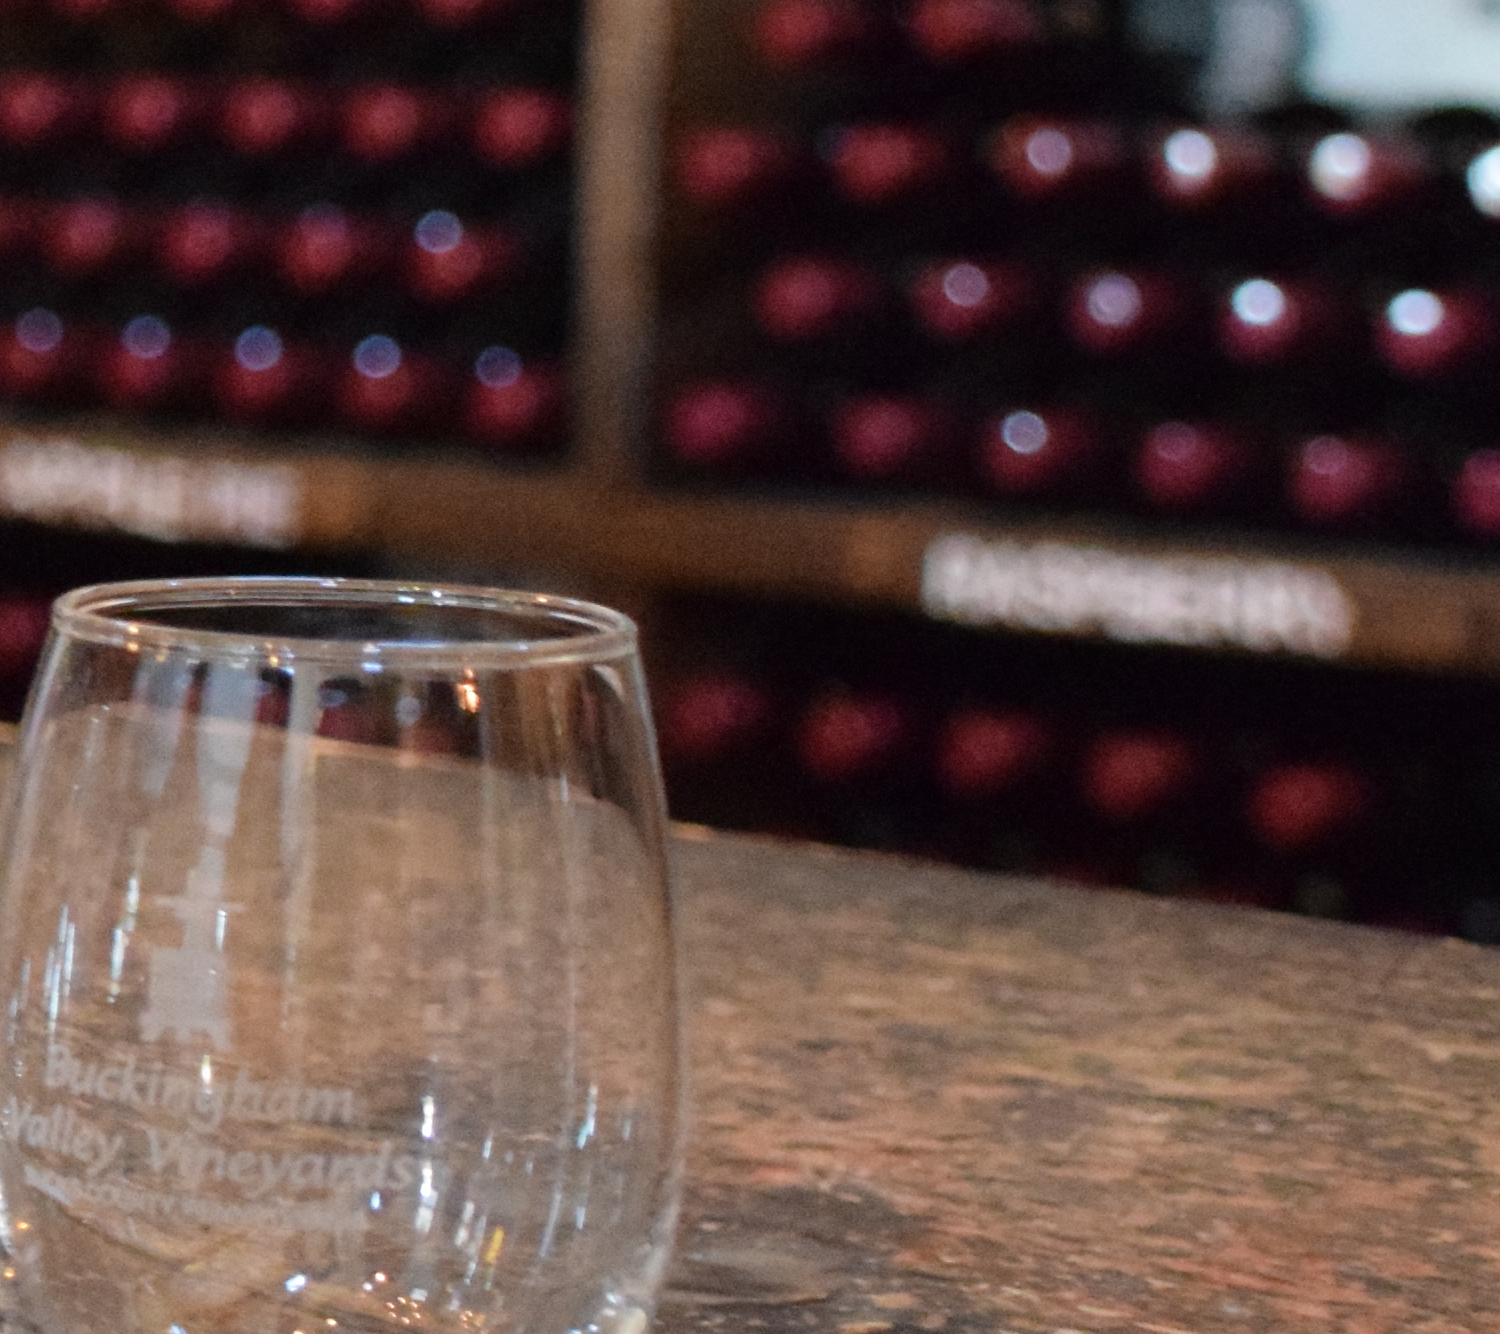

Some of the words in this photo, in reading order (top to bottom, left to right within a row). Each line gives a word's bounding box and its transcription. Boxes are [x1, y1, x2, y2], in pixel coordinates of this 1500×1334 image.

[45, 1044, 354, 1132] Buckingham
[2, 1097, 123, 1174] Valley
[148, 1127, 416, 1198] Vineyards
